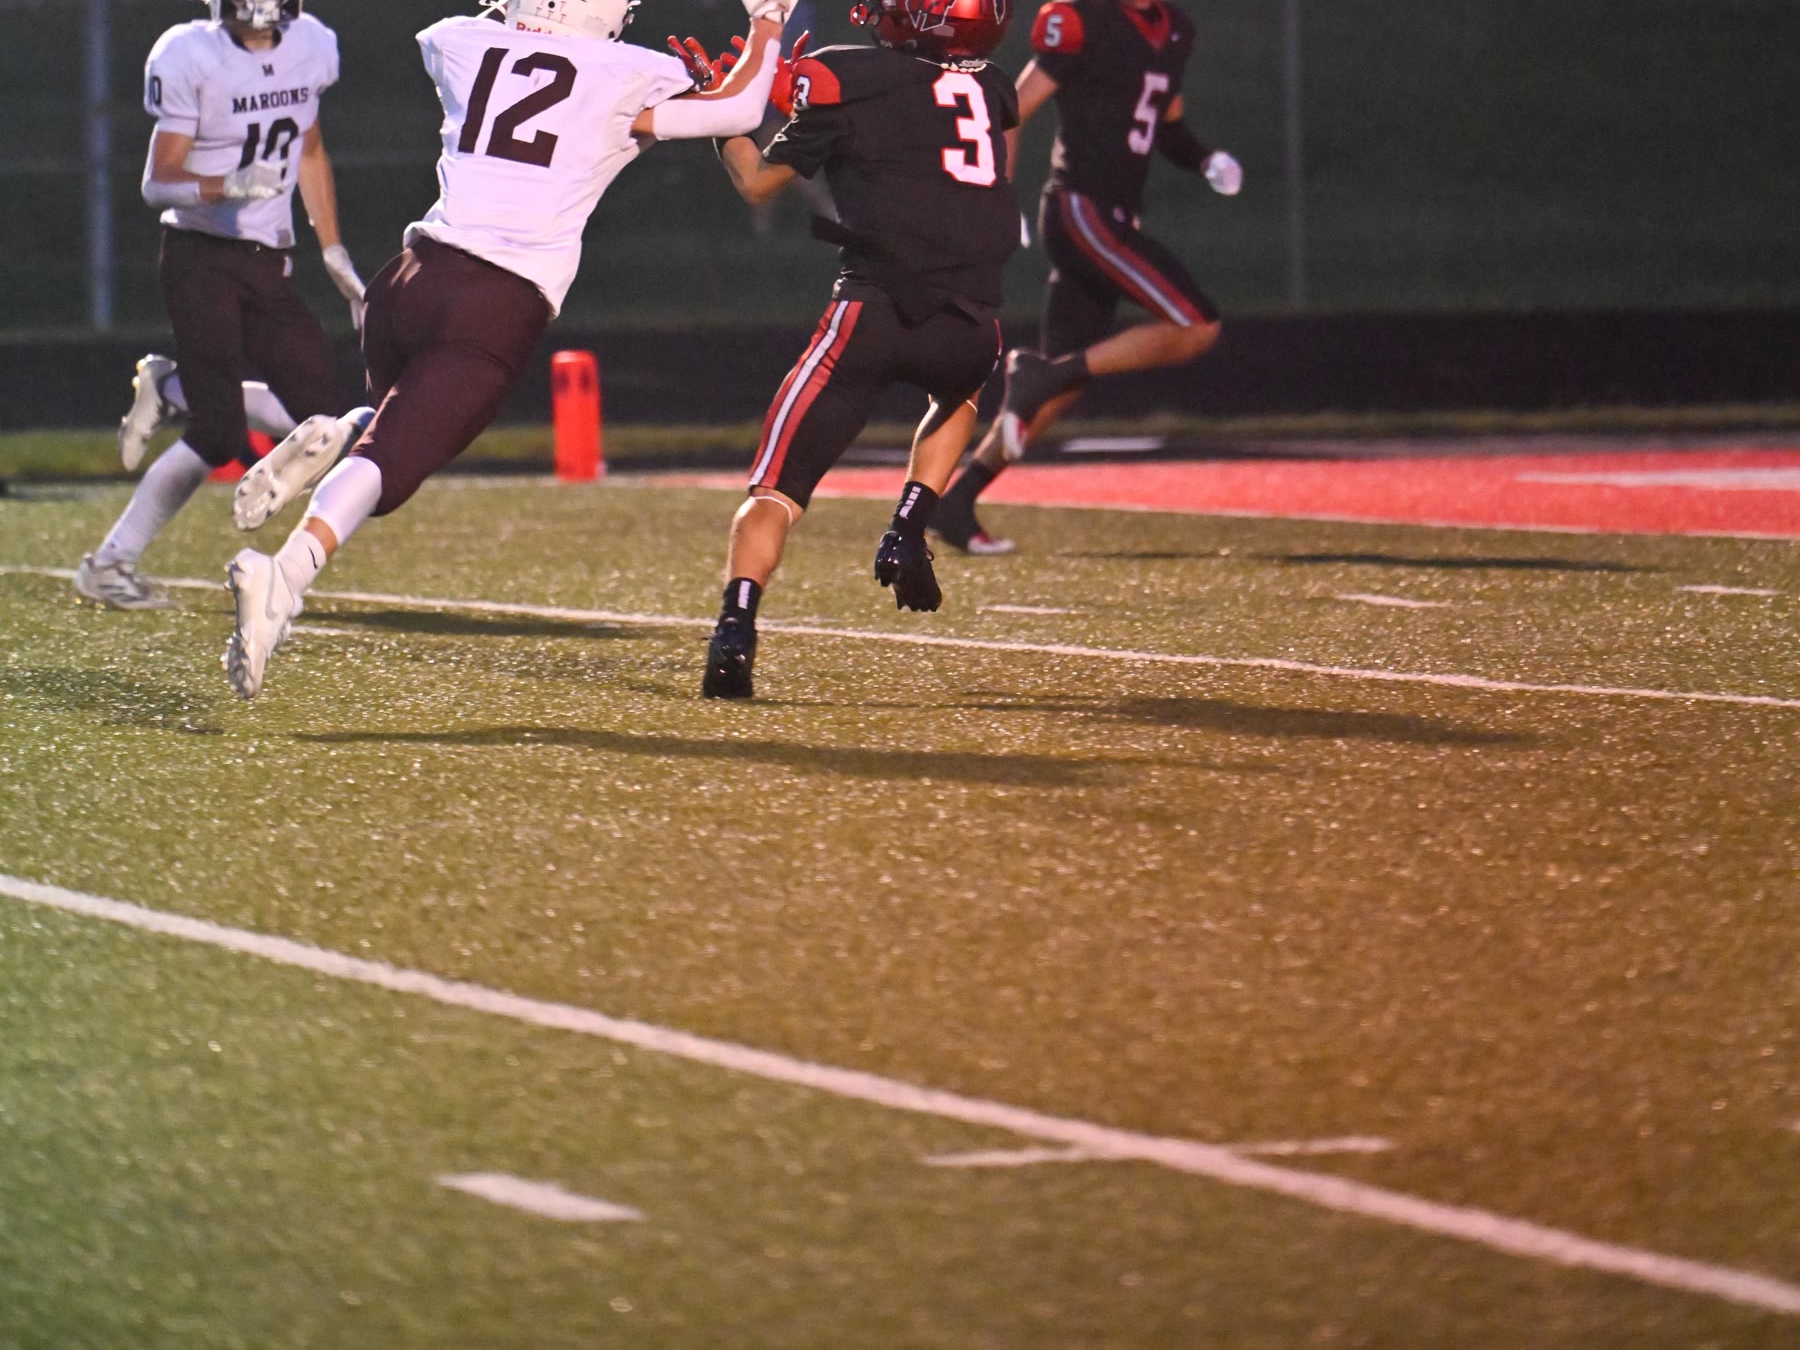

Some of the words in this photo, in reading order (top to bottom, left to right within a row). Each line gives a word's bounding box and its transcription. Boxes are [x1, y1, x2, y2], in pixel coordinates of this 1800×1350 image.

[1044, 13, 1064, 47] 5
[262, 63, 275, 77] M
[232, 87, 309, 114] MAROONS
[458, 47, 578, 168] 12
[796, 75, 810, 111] 3
[932, 70, 997, 187] 3
[1128, 72, 1169, 155] 5
